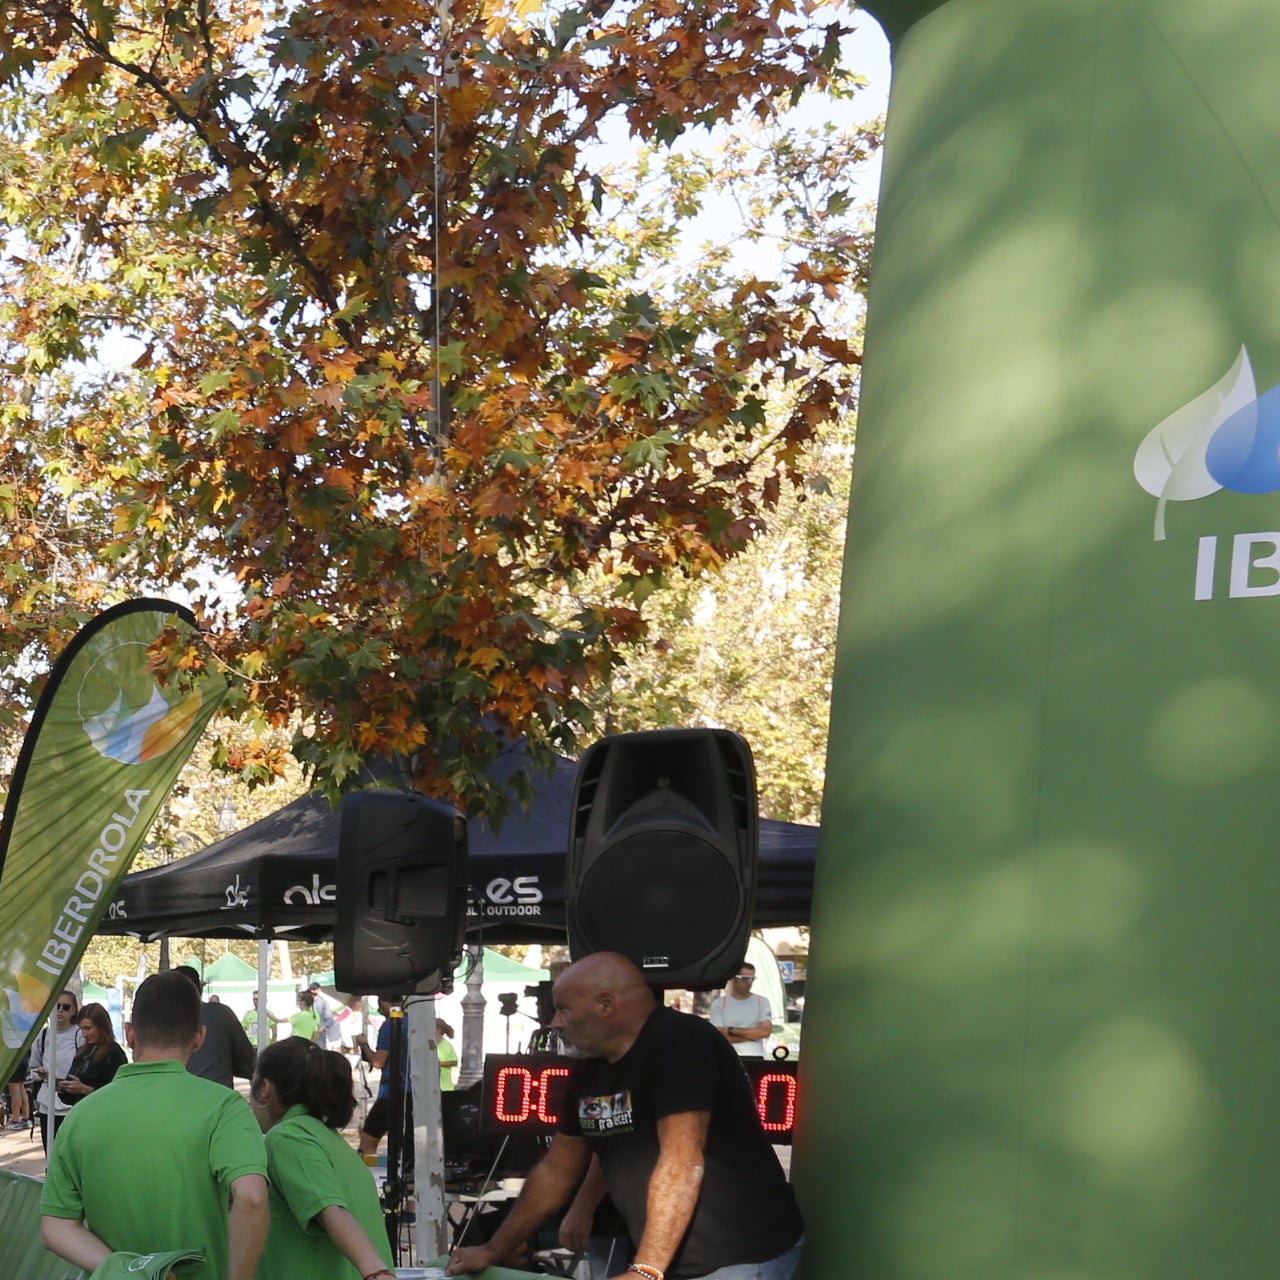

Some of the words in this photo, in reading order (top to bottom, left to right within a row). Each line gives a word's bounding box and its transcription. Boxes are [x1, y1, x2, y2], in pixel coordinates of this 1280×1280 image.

[1194, 532, 1280, 601] IB
[36, 788, 150, 977] IBERDROLA
[487, 906, 541, 916] OUTDOOR
